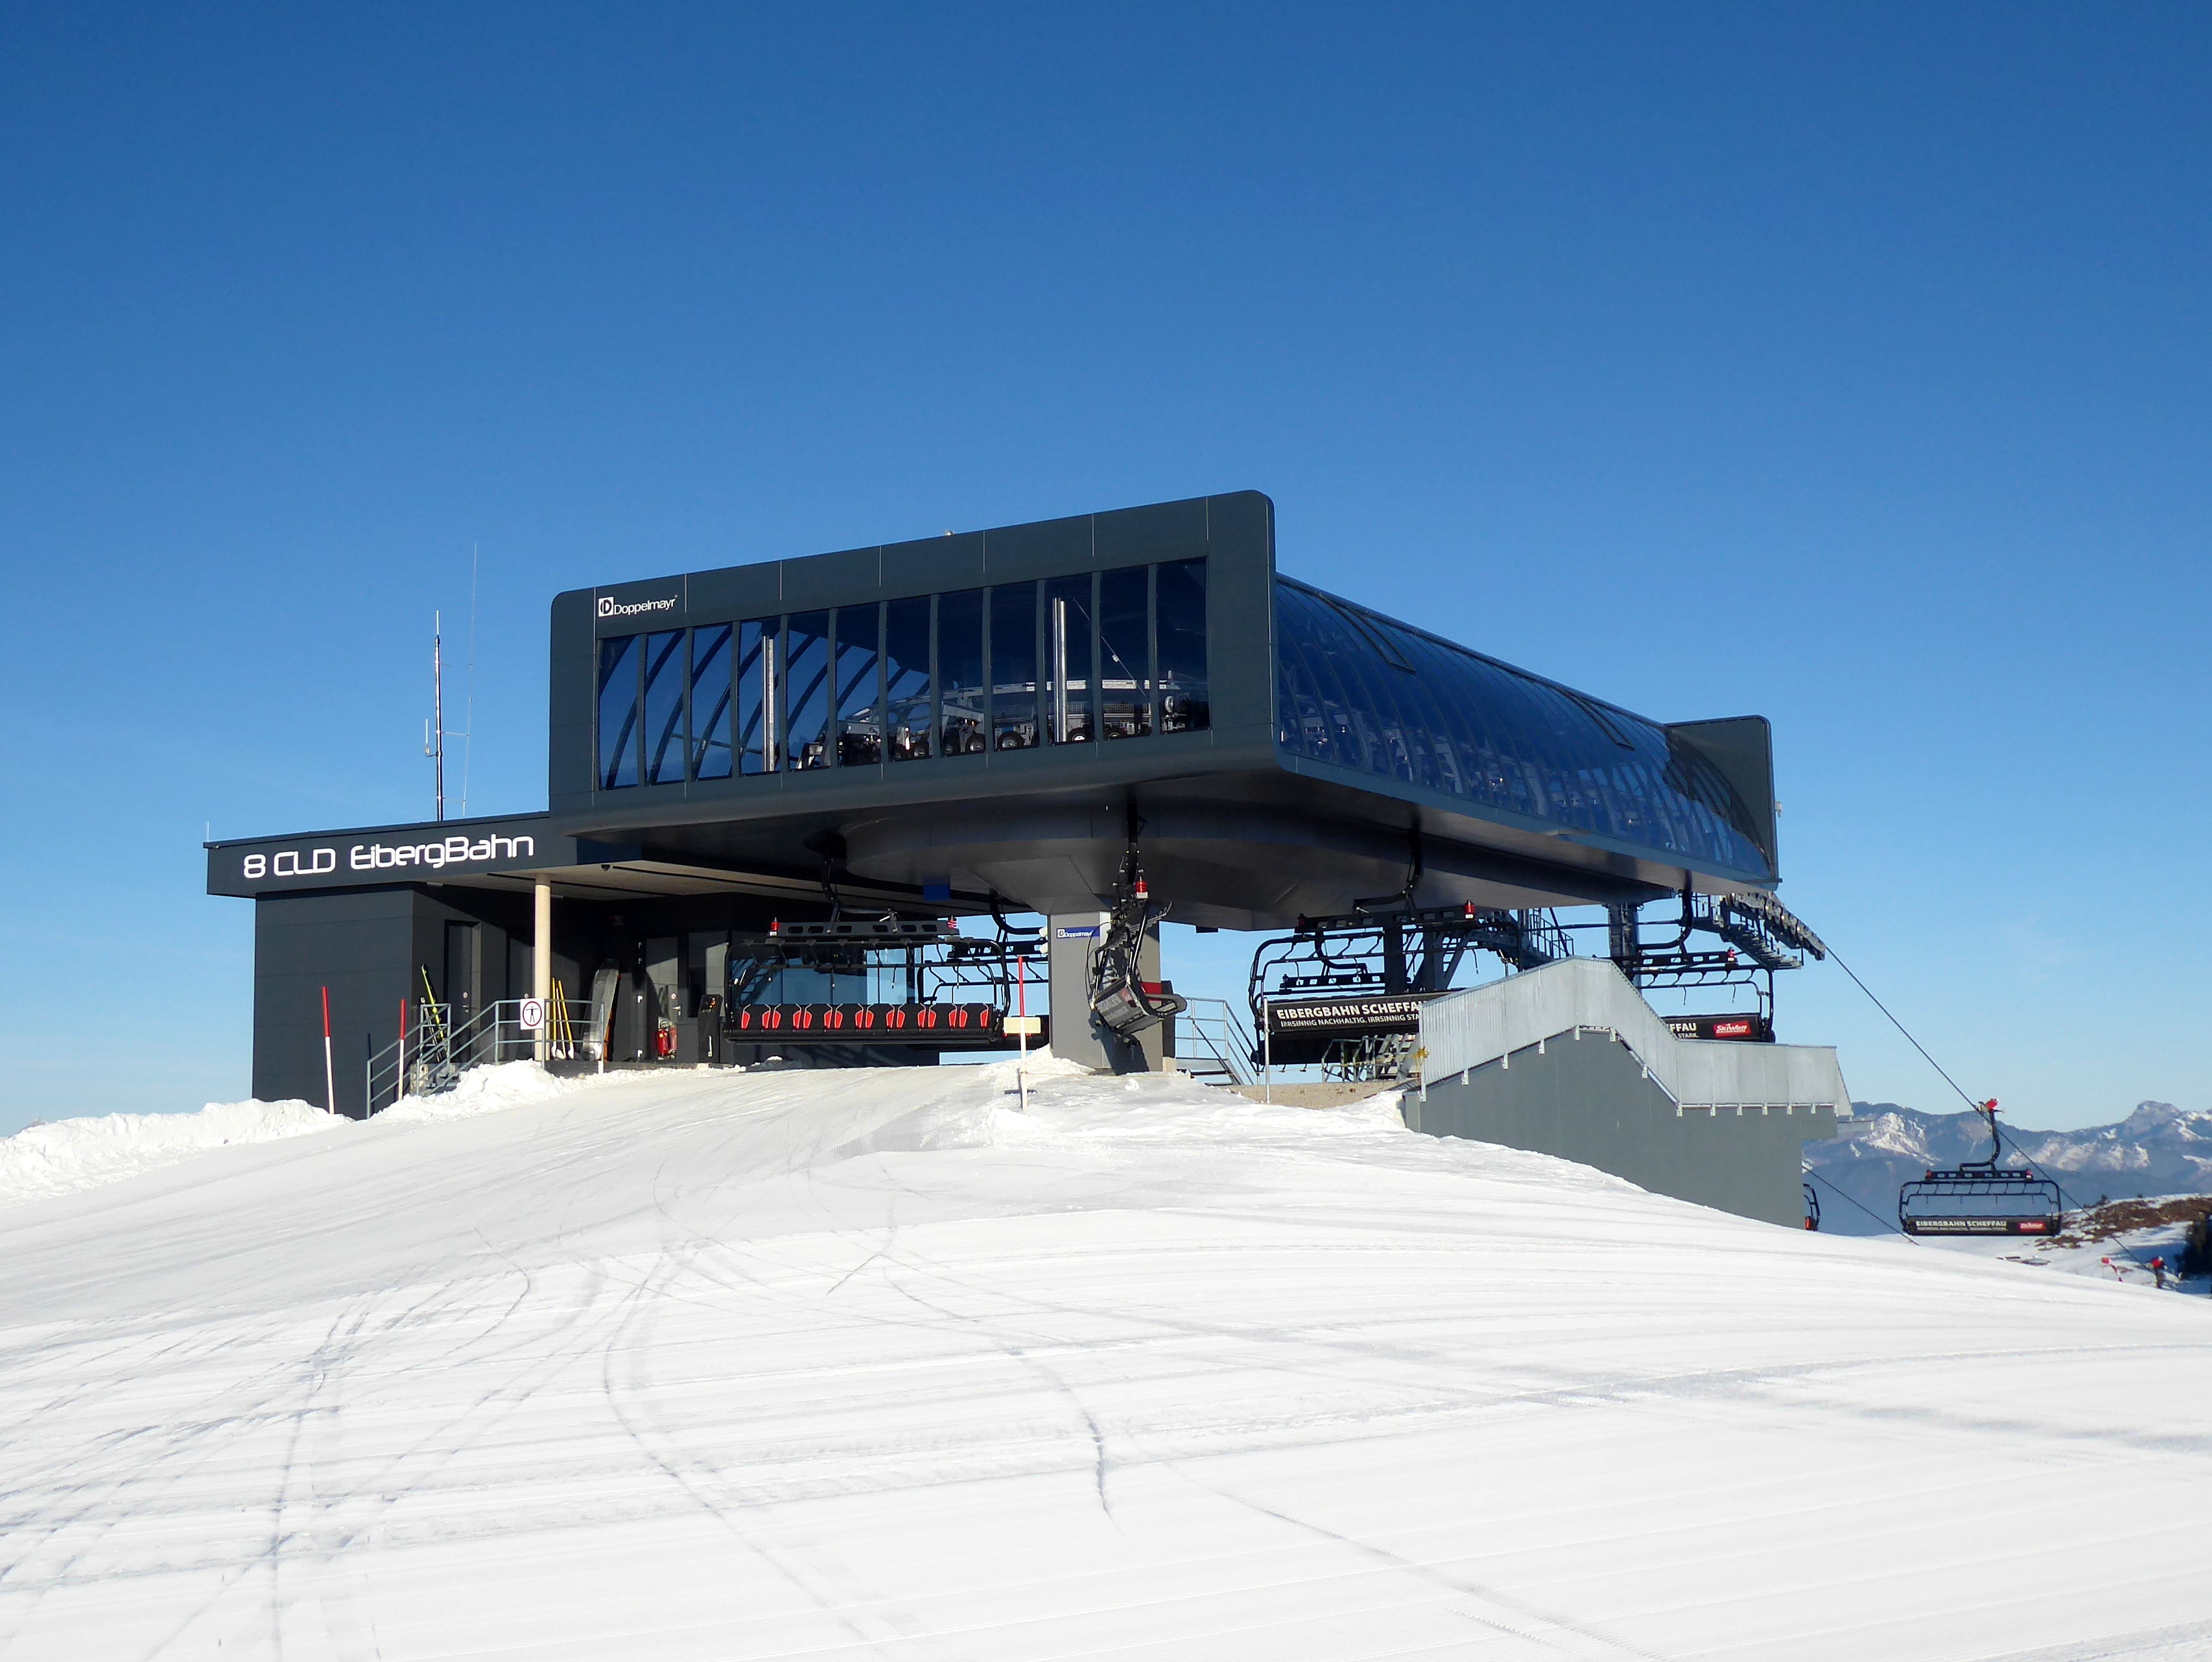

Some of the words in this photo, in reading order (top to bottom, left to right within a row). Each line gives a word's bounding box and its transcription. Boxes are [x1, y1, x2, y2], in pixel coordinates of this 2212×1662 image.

[614, 598, 676, 615] Doppelmayr
[243, 854, 266, 879] 8
[274, 848, 336, 876] CLD
[350, 833, 534, 870] EibergBahn
[1277, 1004, 1360, 1019] EIBERGBAHN
[1363, 1001, 1428, 1015] SCHEFFA
[1280, 1019, 1317, 1028] IRRSINNIG
[1318, 1017, 1367, 1026] NACHHALTIG.
[1368, 1014, 1406, 1023] IRRSINNIG
